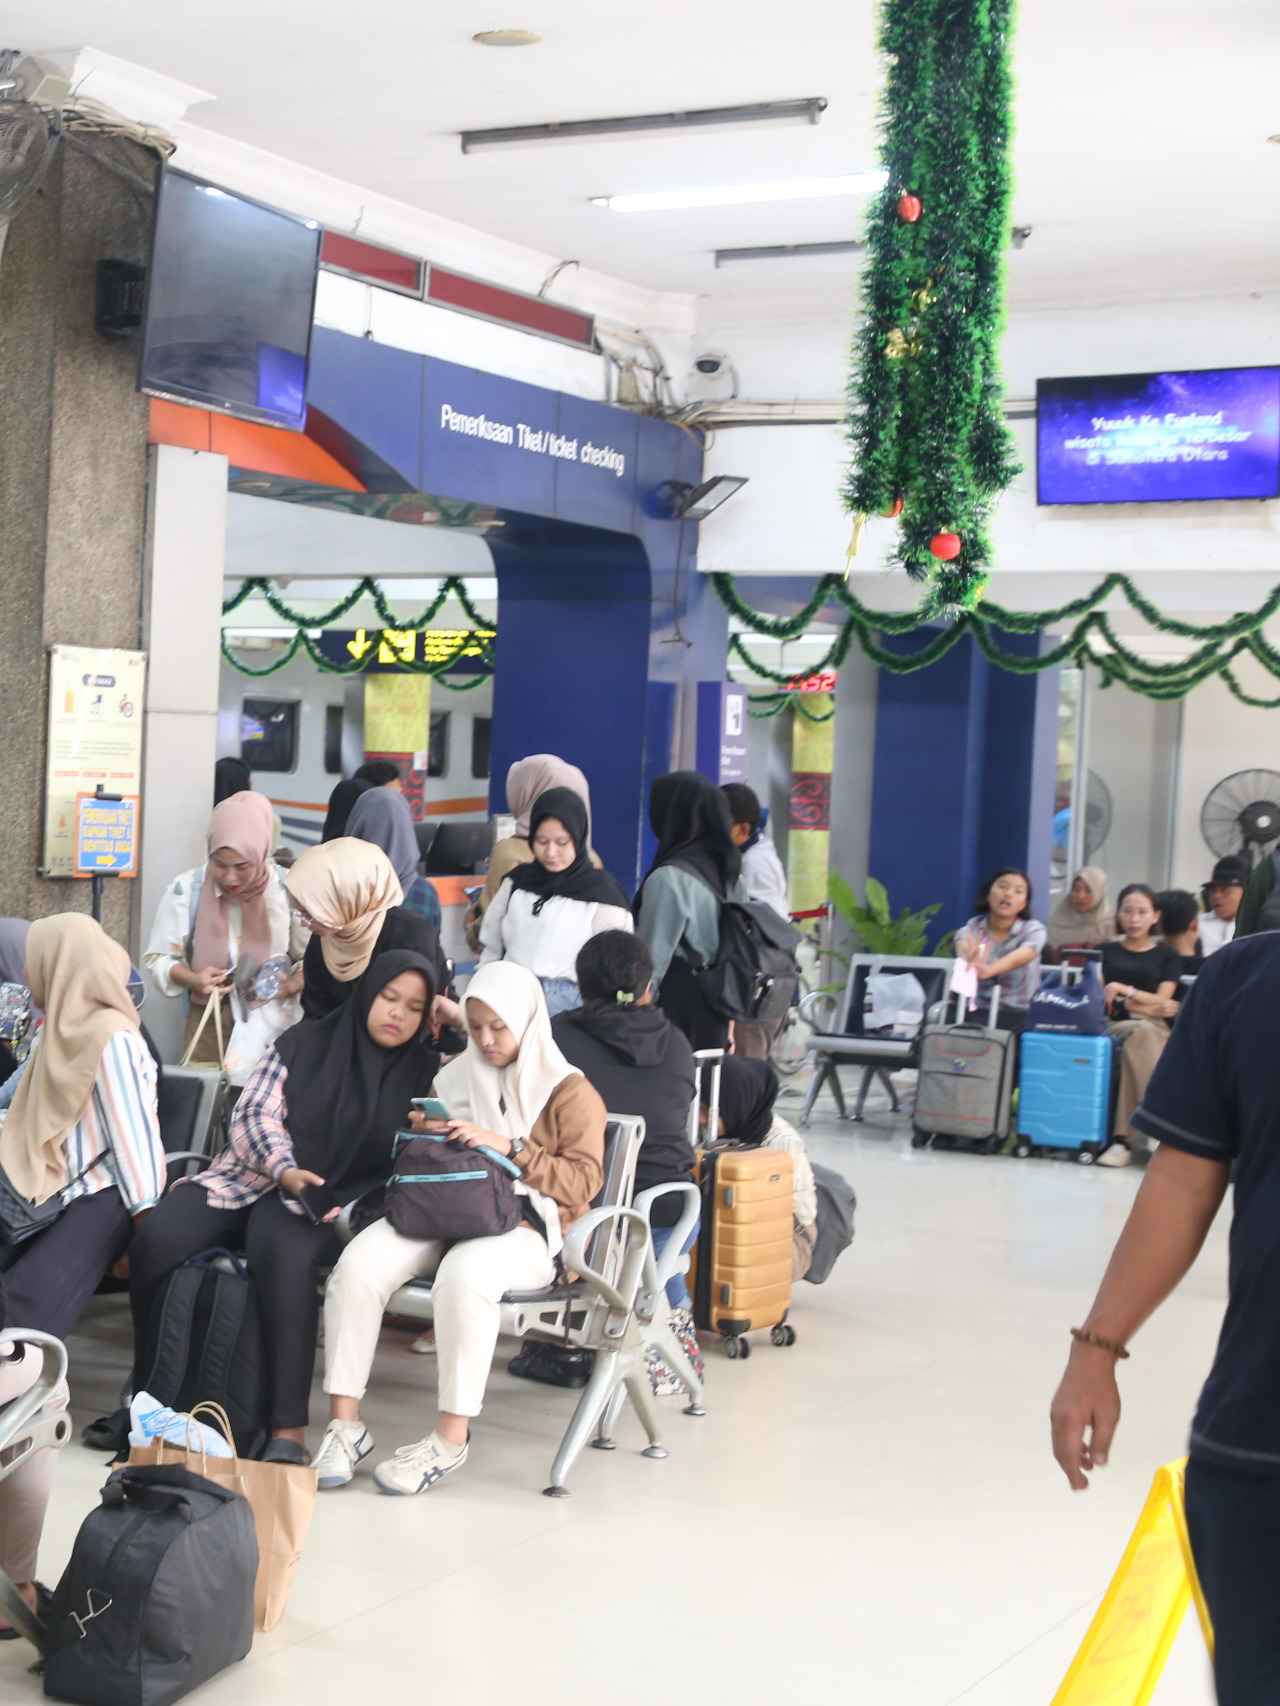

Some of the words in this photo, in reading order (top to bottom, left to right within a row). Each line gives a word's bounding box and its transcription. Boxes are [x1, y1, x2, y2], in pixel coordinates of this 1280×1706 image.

[441, 403, 514, 446] Pemeriksaan
[581, 441, 625, 478] checking
[1064, 435, 1111, 450] wisata
[1182, 448, 1229, 463] Utara
